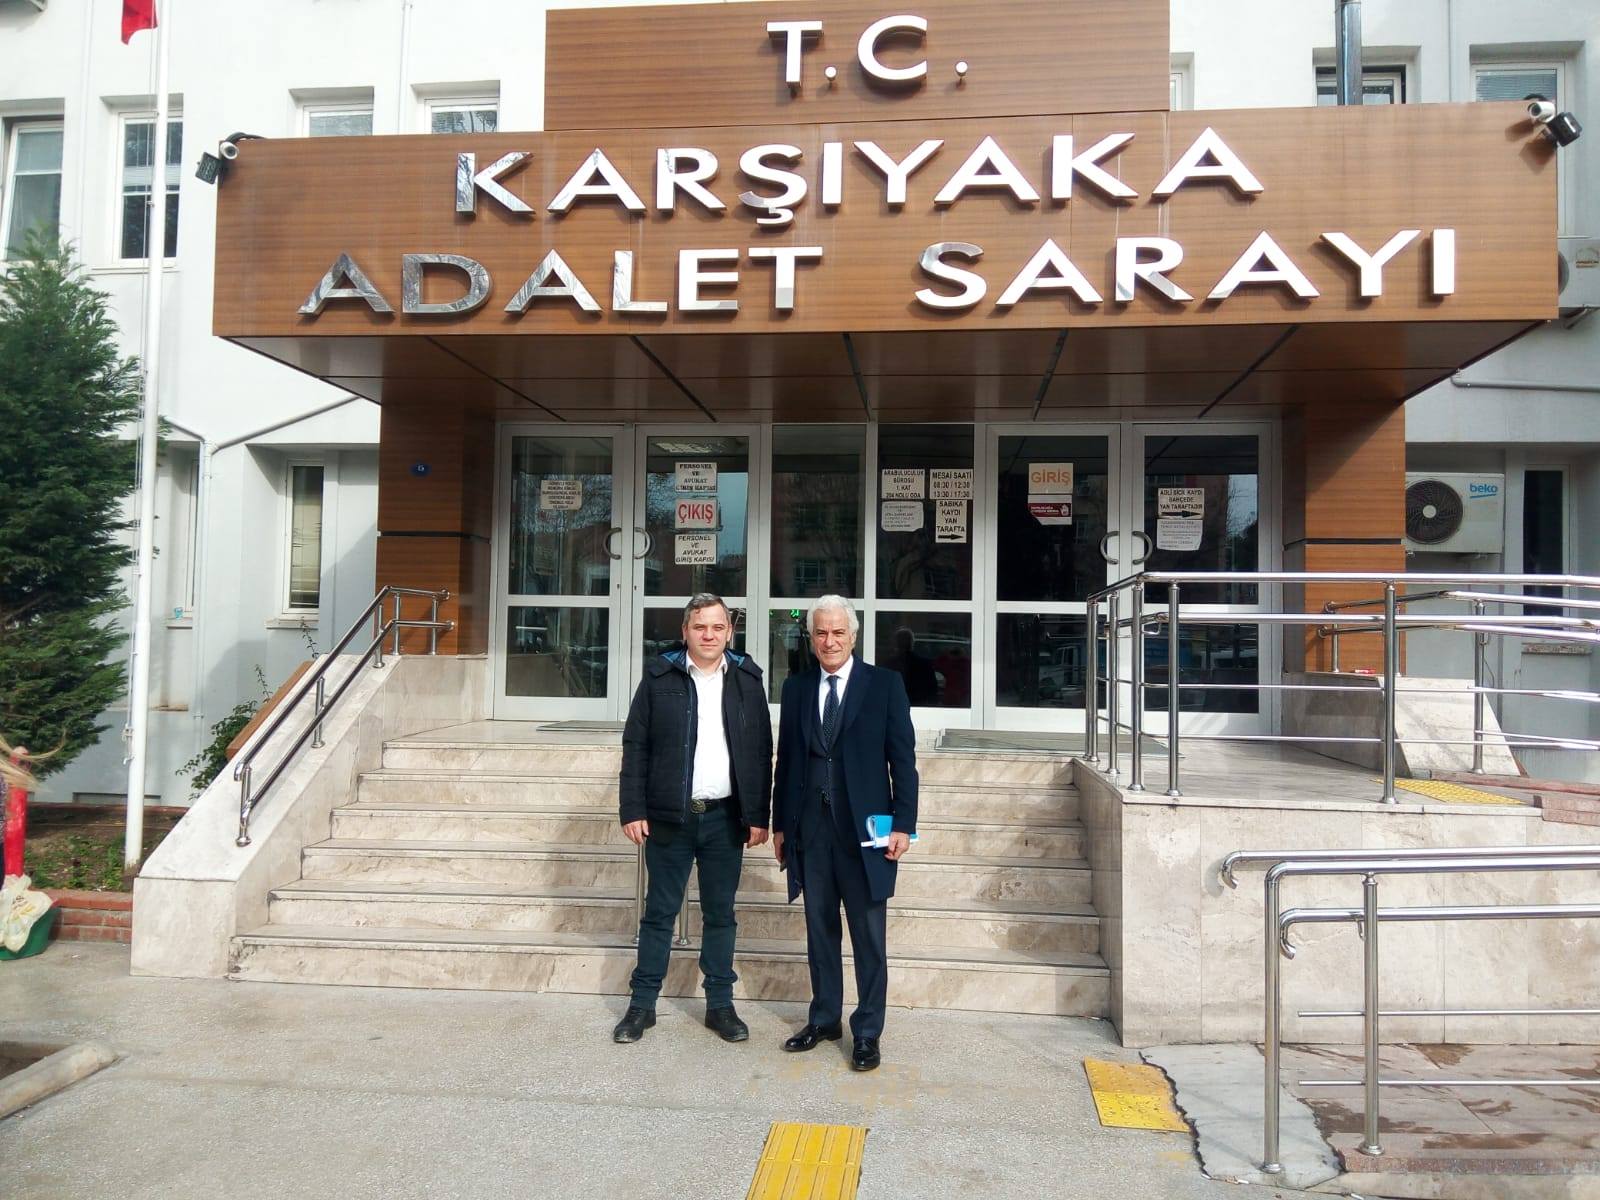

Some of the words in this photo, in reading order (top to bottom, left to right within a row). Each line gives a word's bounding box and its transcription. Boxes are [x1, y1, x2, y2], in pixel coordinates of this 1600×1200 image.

[456, 126, 1264, 226] KARŞIYAKA
[298, 245, 823, 315] ADALET
[914, 227, 1455, 310] SARAYI
[932, 471, 952, 479] MESAİ
[953, 471, 972, 479] SAATİ
[1031, 468, 1071, 486] GİRİŞ
[954, 481, 970, 489] 12:30
[1470, 483, 1498, 493] beko
[678, 503, 714, 523] ÇIKIŞ
